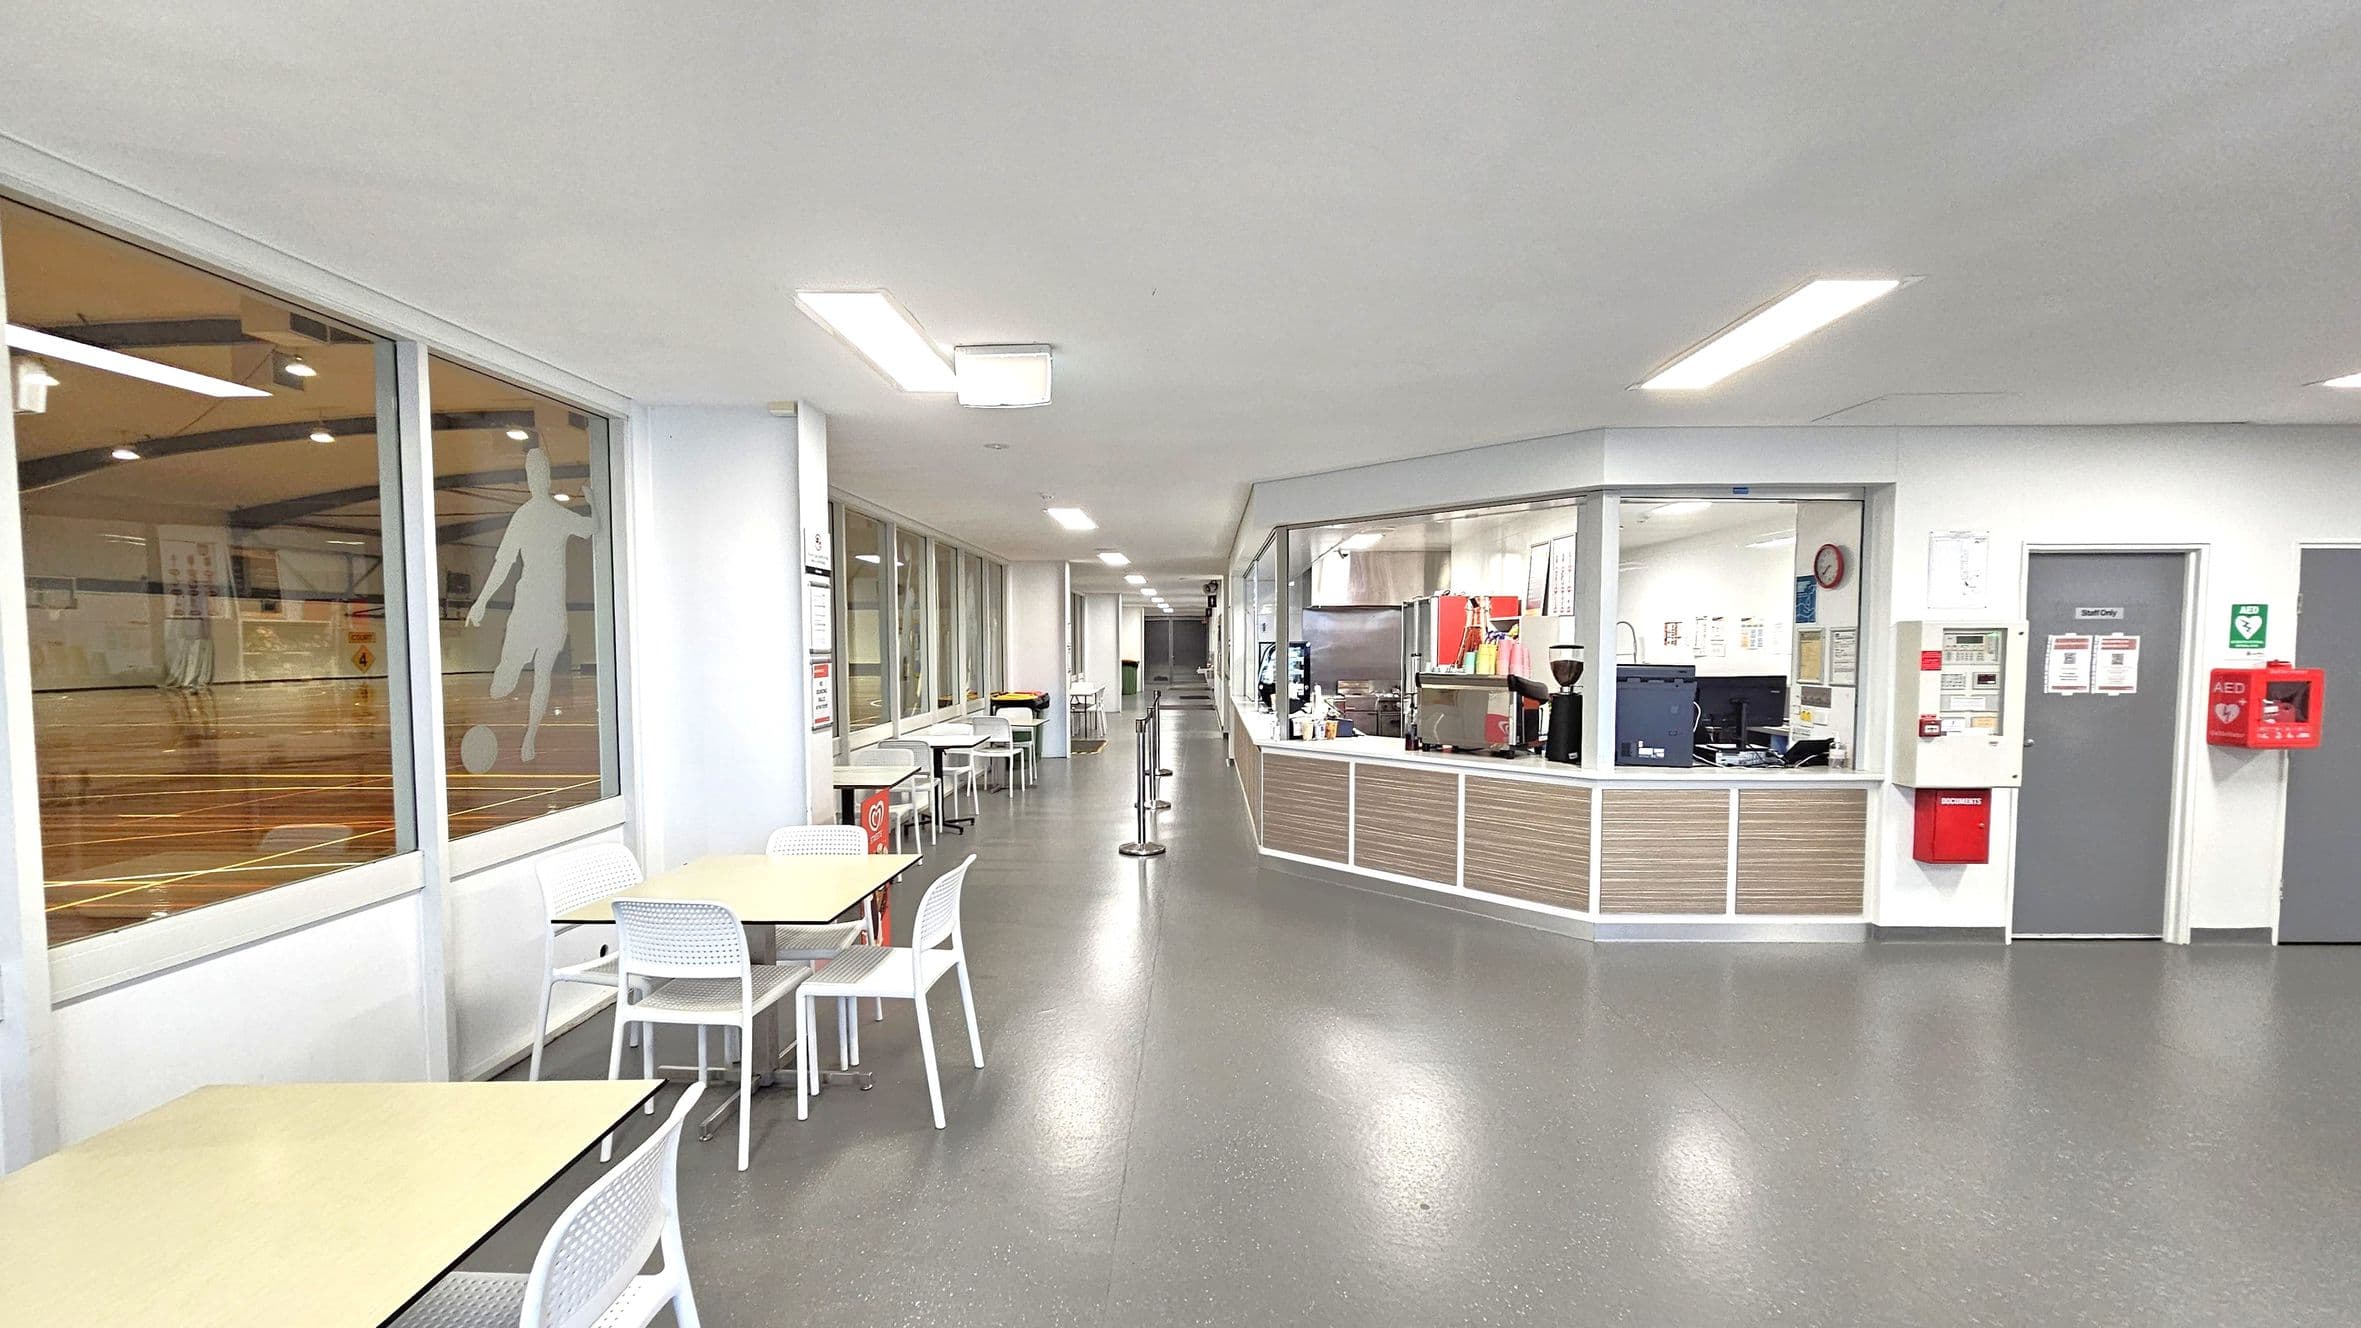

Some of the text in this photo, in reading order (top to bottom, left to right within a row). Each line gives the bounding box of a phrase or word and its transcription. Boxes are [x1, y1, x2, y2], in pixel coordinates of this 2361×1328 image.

[2100, 609, 2117, 617] Only
[2239, 606, 2259, 615] AED
[359, 652, 368, 667] 4
[2213, 682, 2245, 693] AED
